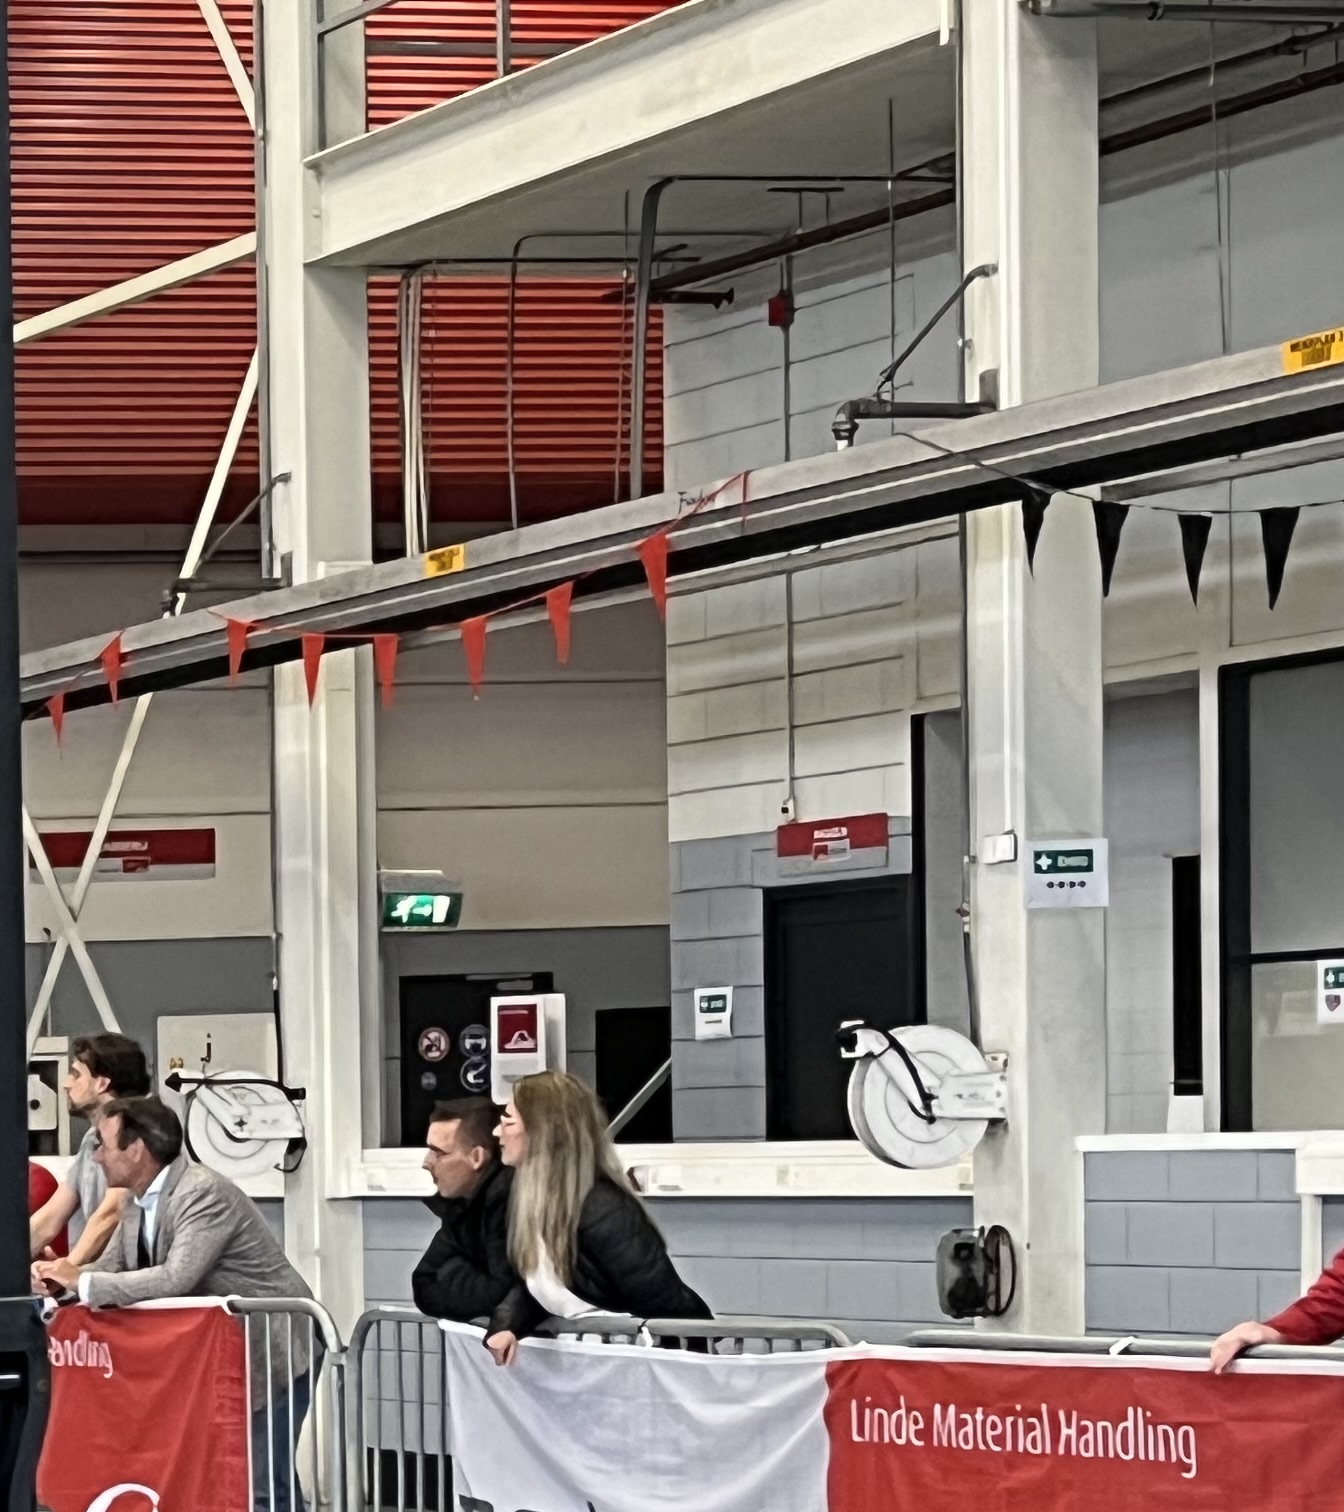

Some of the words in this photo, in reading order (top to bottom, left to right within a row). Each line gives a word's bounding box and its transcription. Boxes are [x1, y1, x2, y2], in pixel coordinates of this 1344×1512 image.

[48, 1329, 114, 1379] andling
[850, 1394, 925, 1447] Linde
[932, 1402, 1052, 1455] Material
[1058, 1406, 1198, 1479] Handling
